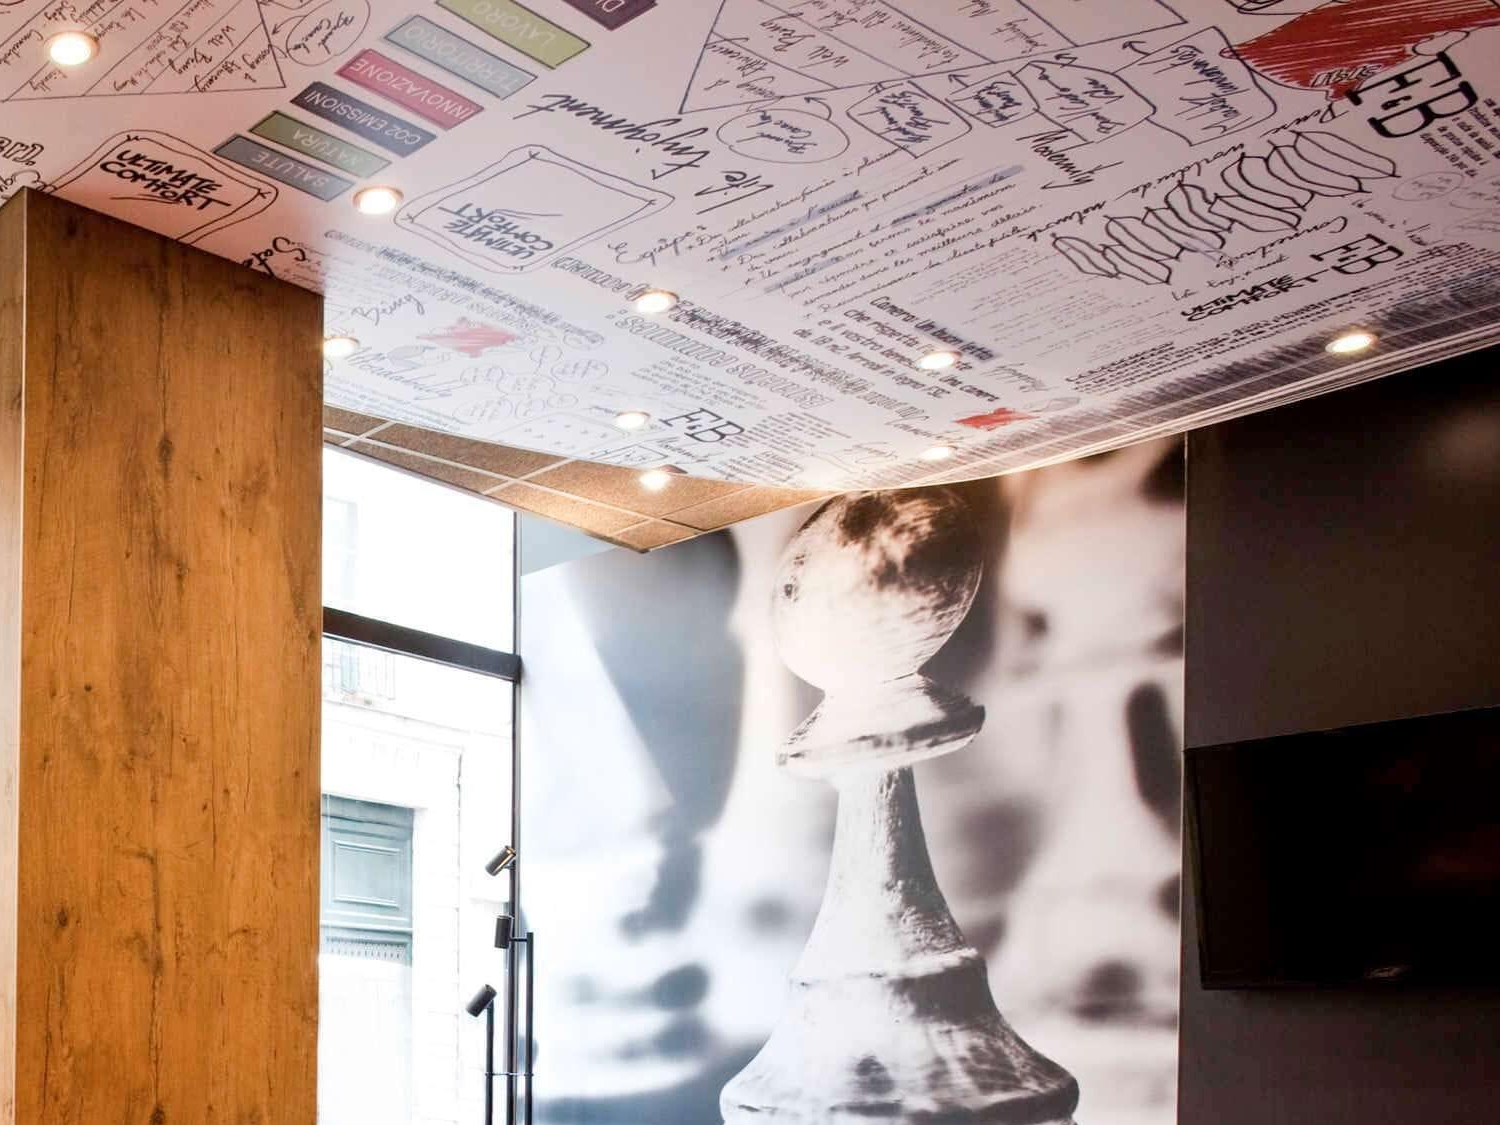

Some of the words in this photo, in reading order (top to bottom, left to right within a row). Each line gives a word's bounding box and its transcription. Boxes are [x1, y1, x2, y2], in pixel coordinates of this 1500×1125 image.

[471, 2, 557, 48] LAVORO
[404, 22, 514, 92] TERRITORIO
[303, 89, 389, 134] EMISSIONI
[348, 58, 474, 120] INNOVAZIONE
[252, 151, 331, 189] SALUTE
[291, 127, 360, 168] NATURA
[99, 160, 232, 211] COMFORT
[116, 149, 223, 194] ULTIMATE
[440, 215, 535, 261] ULTIMATE
[843, 309, 872, 323] che
[869, 295, 919, 323] Camera:
[1180, 274, 1294, 318] ULTIMATE
[1186, 268, 1331, 322] COMFORT
